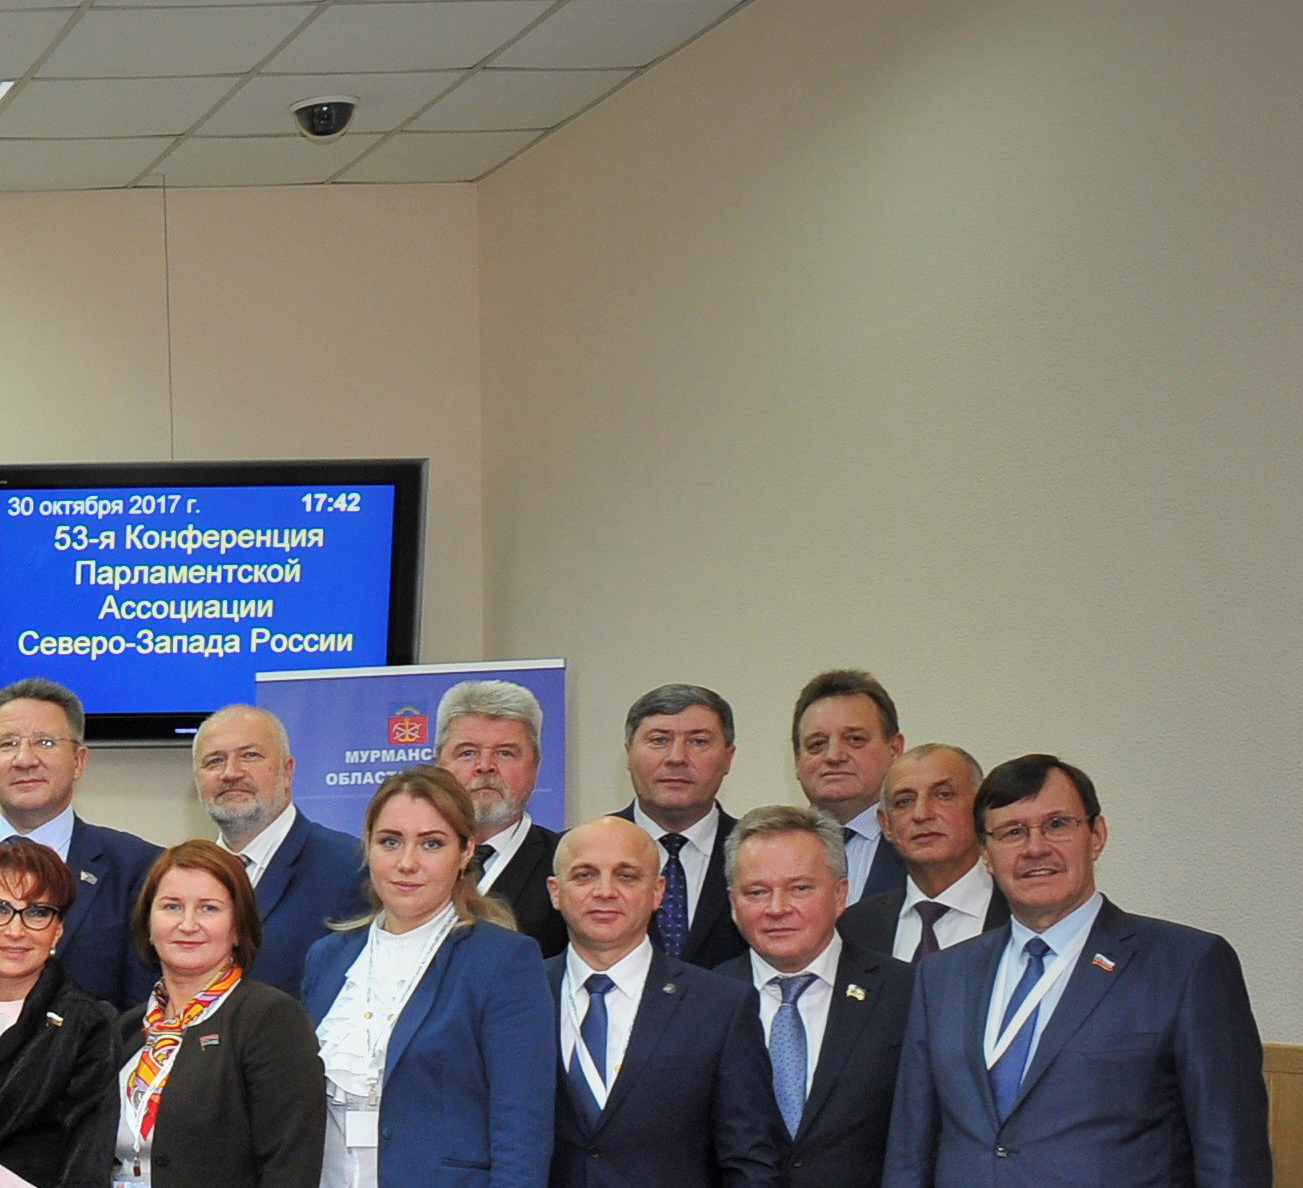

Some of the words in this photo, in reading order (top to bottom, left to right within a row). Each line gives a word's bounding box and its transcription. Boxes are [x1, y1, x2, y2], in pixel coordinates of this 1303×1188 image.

[7, 496, 34, 516] 30
[39, 496, 124, 519] октября
[129, 495, 182, 514] 2017
[186, 498, 200, 514] г.
[301, 492, 361, 512] 17:42
[54, 525, 116, 551] 53-я
[125, 523, 324, 555] Конференция
[75, 558, 301, 591] Парламентской
[97, 594, 273, 624] Ассоциации
[18, 628, 241, 661] Северо-Запада
[250, 627, 353, 653] России
[345, 748, 433, 763] МУРМАНС
[325, 771, 402, 785] ОБЛАС
